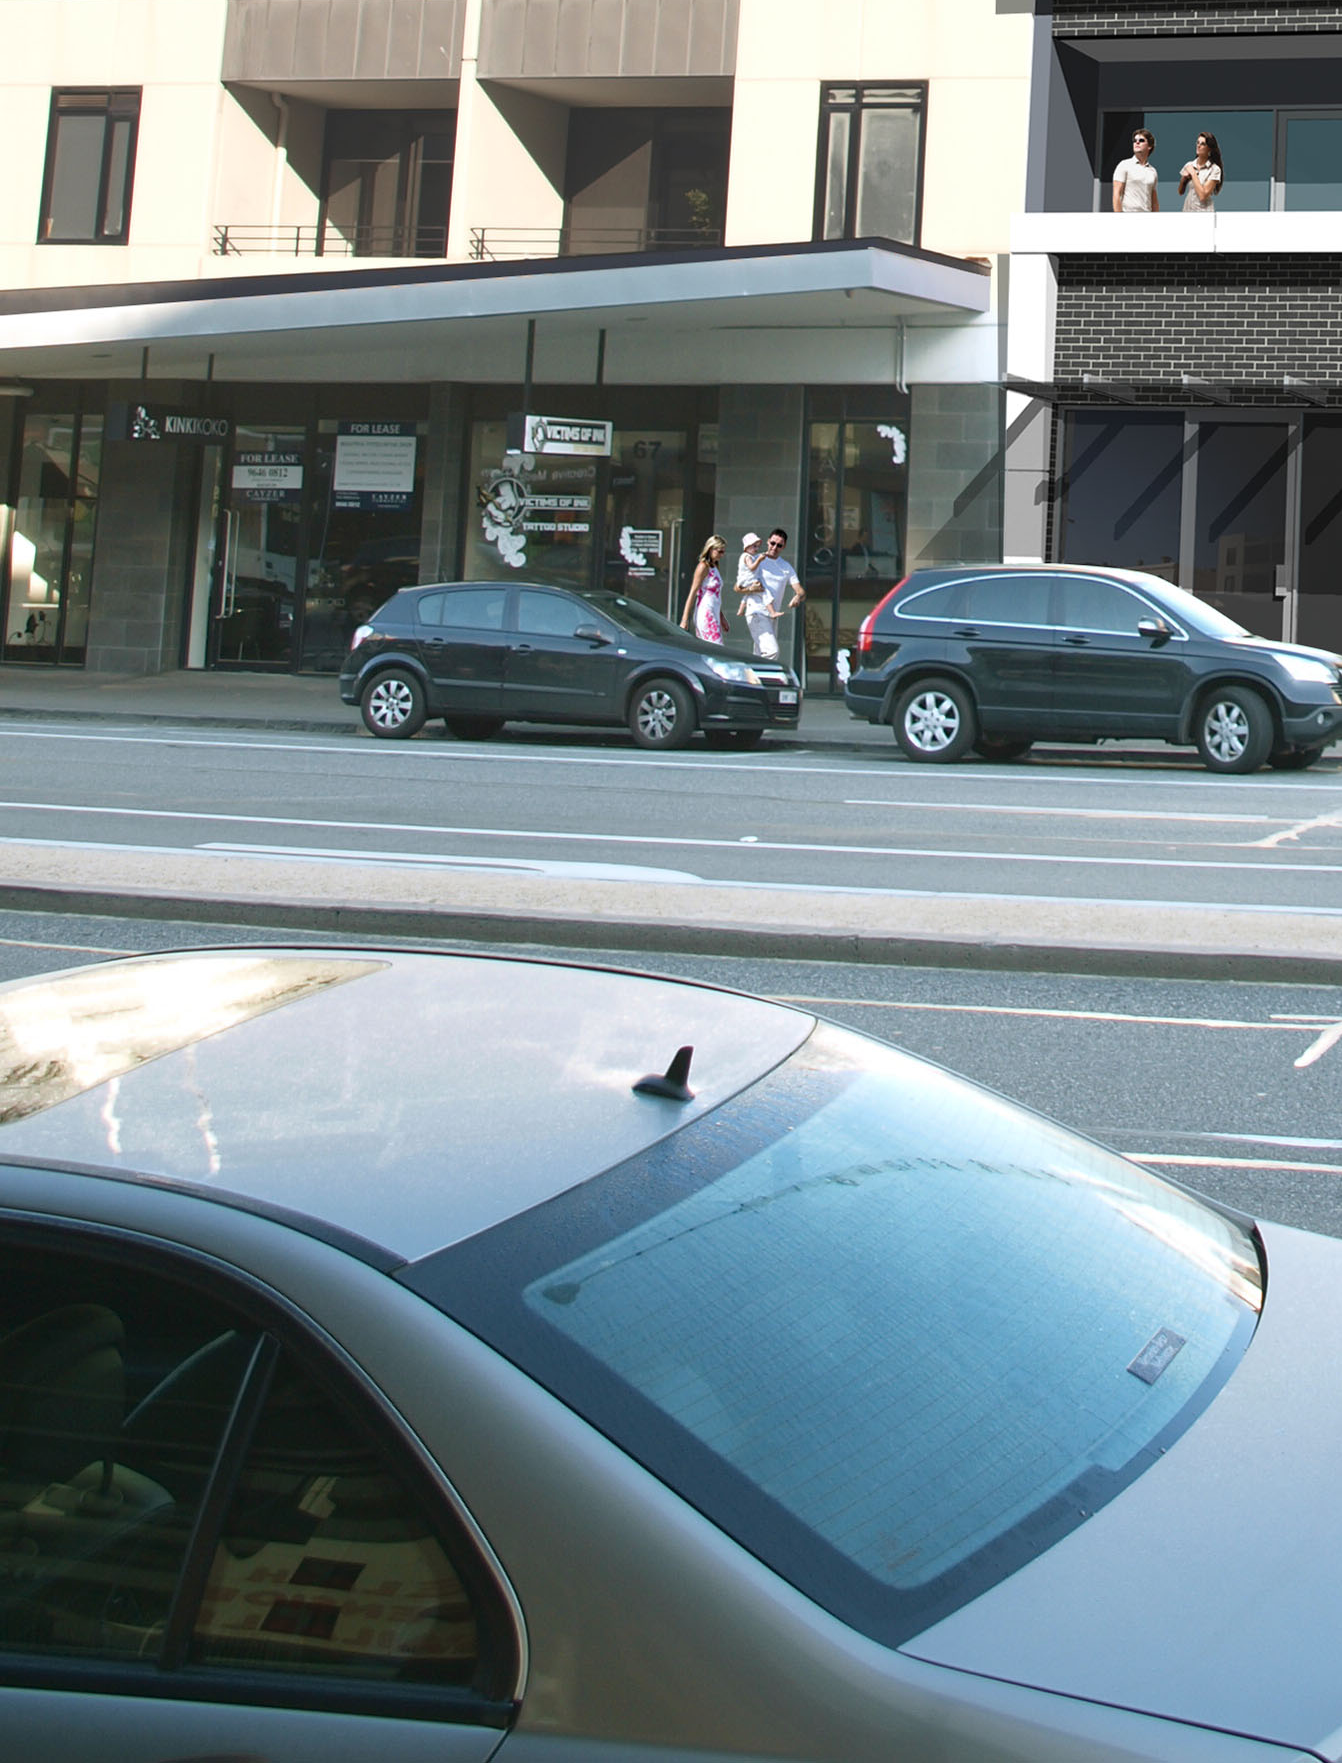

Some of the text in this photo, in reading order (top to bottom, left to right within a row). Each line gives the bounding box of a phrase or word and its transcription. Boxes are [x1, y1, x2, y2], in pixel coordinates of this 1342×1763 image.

[350, 423, 401, 434] FOR LEASE
[546, 424, 605, 443] VICTIMS OF INK
[633, 440, 662, 458] 67
[240, 453, 299, 463] FOR LEASE
[519, 497, 558, 508] VICTIMS
[559, 497, 573, 508] OF
[522, 521, 590, 532] TATTOO STUDIO
